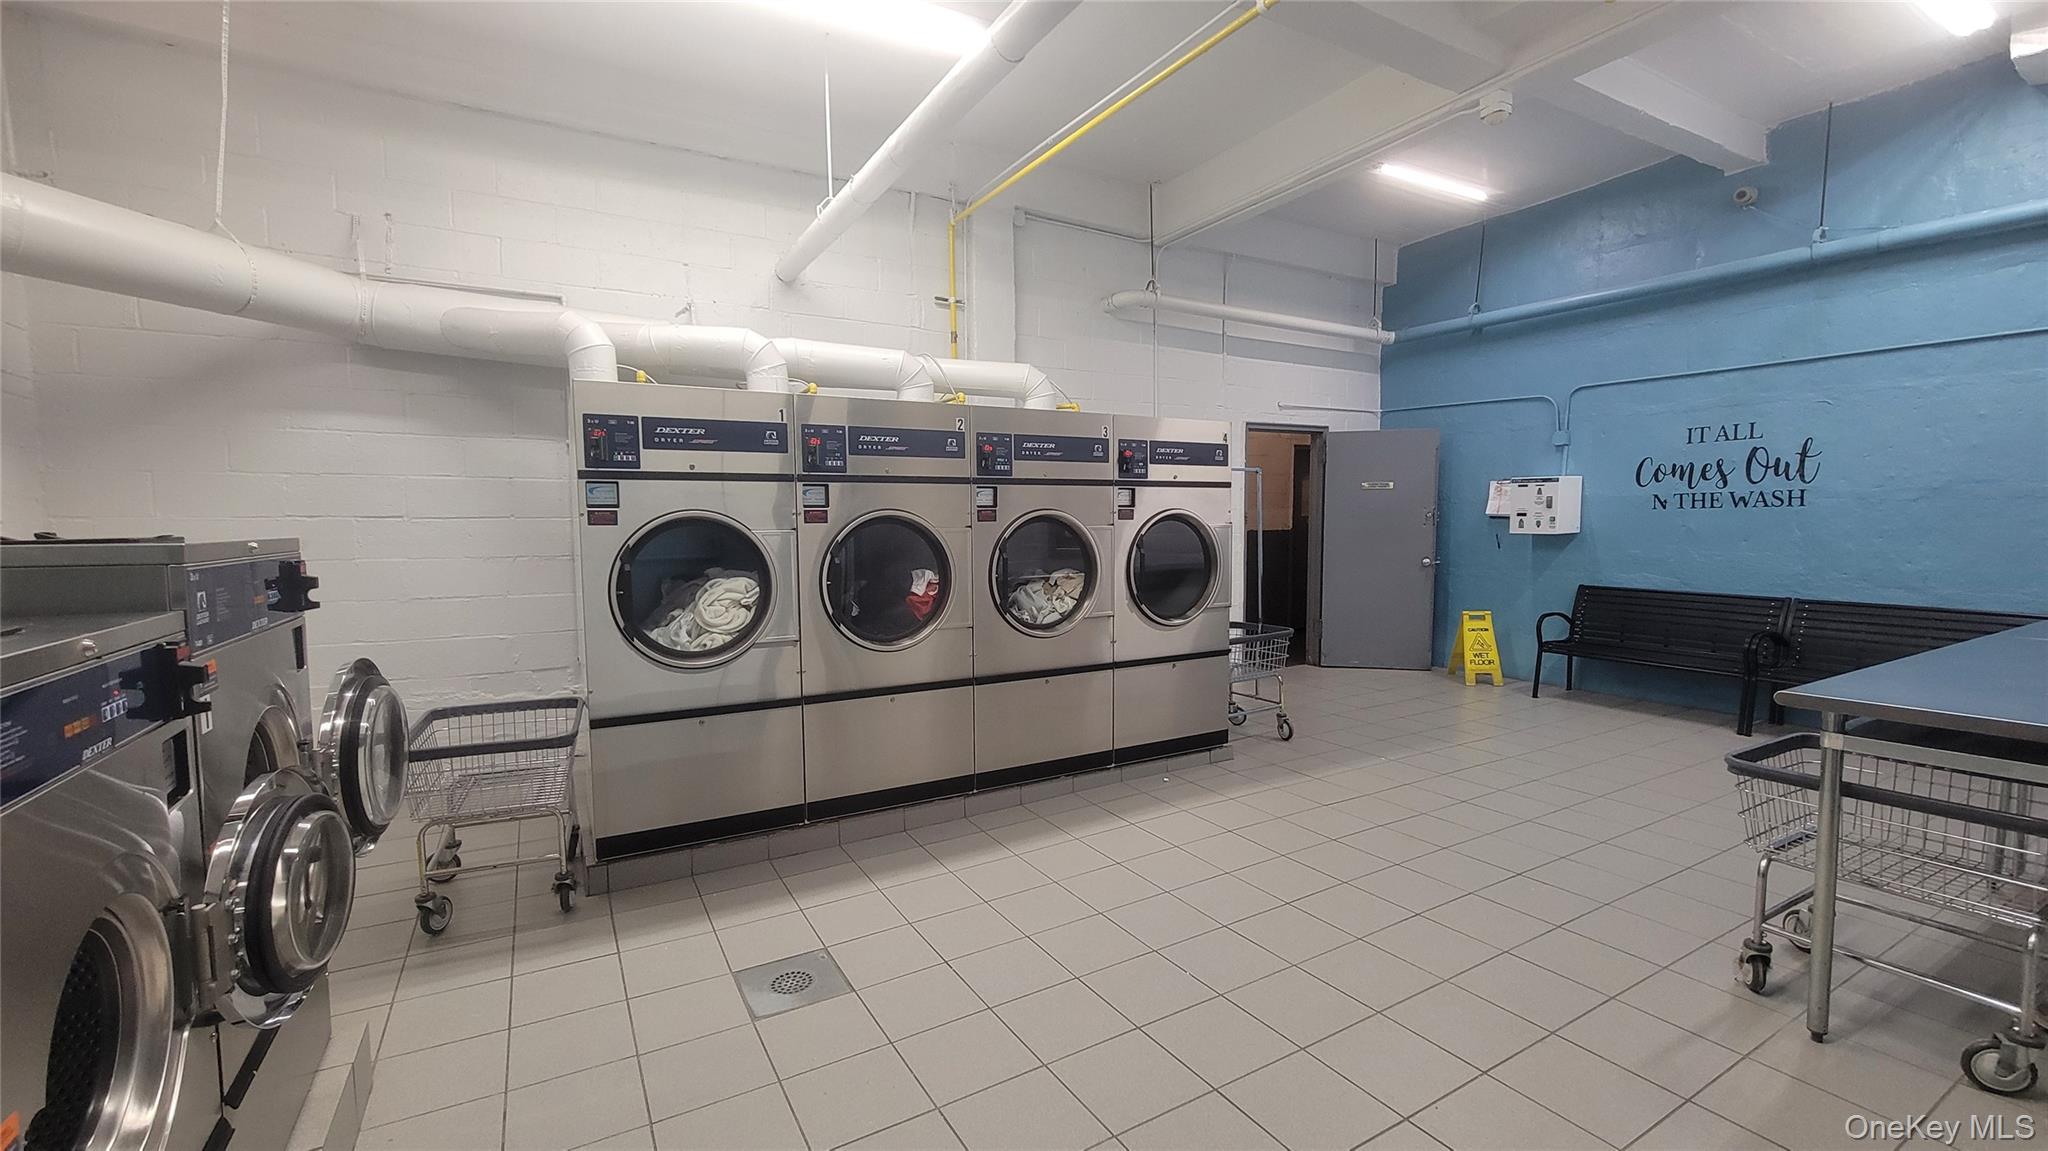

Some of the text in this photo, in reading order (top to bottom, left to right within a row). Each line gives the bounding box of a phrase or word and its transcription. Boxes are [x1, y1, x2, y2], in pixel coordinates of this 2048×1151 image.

[778, 408, 785, 422] 1
[653, 427, 706, 435] DEXTER
[957, 418, 964, 431] 2
[858, 435, 900, 443] DEXTER
[1103, 426, 1109, 438] 3
[1686, 422, 1764, 445] IT ALL
[1635, 437, 1823, 489] Comes Out
[1673, 492, 1723, 509] THE
[1728, 489, 1807, 508] WASH
[82, 736, 113, 760] DEXTER
